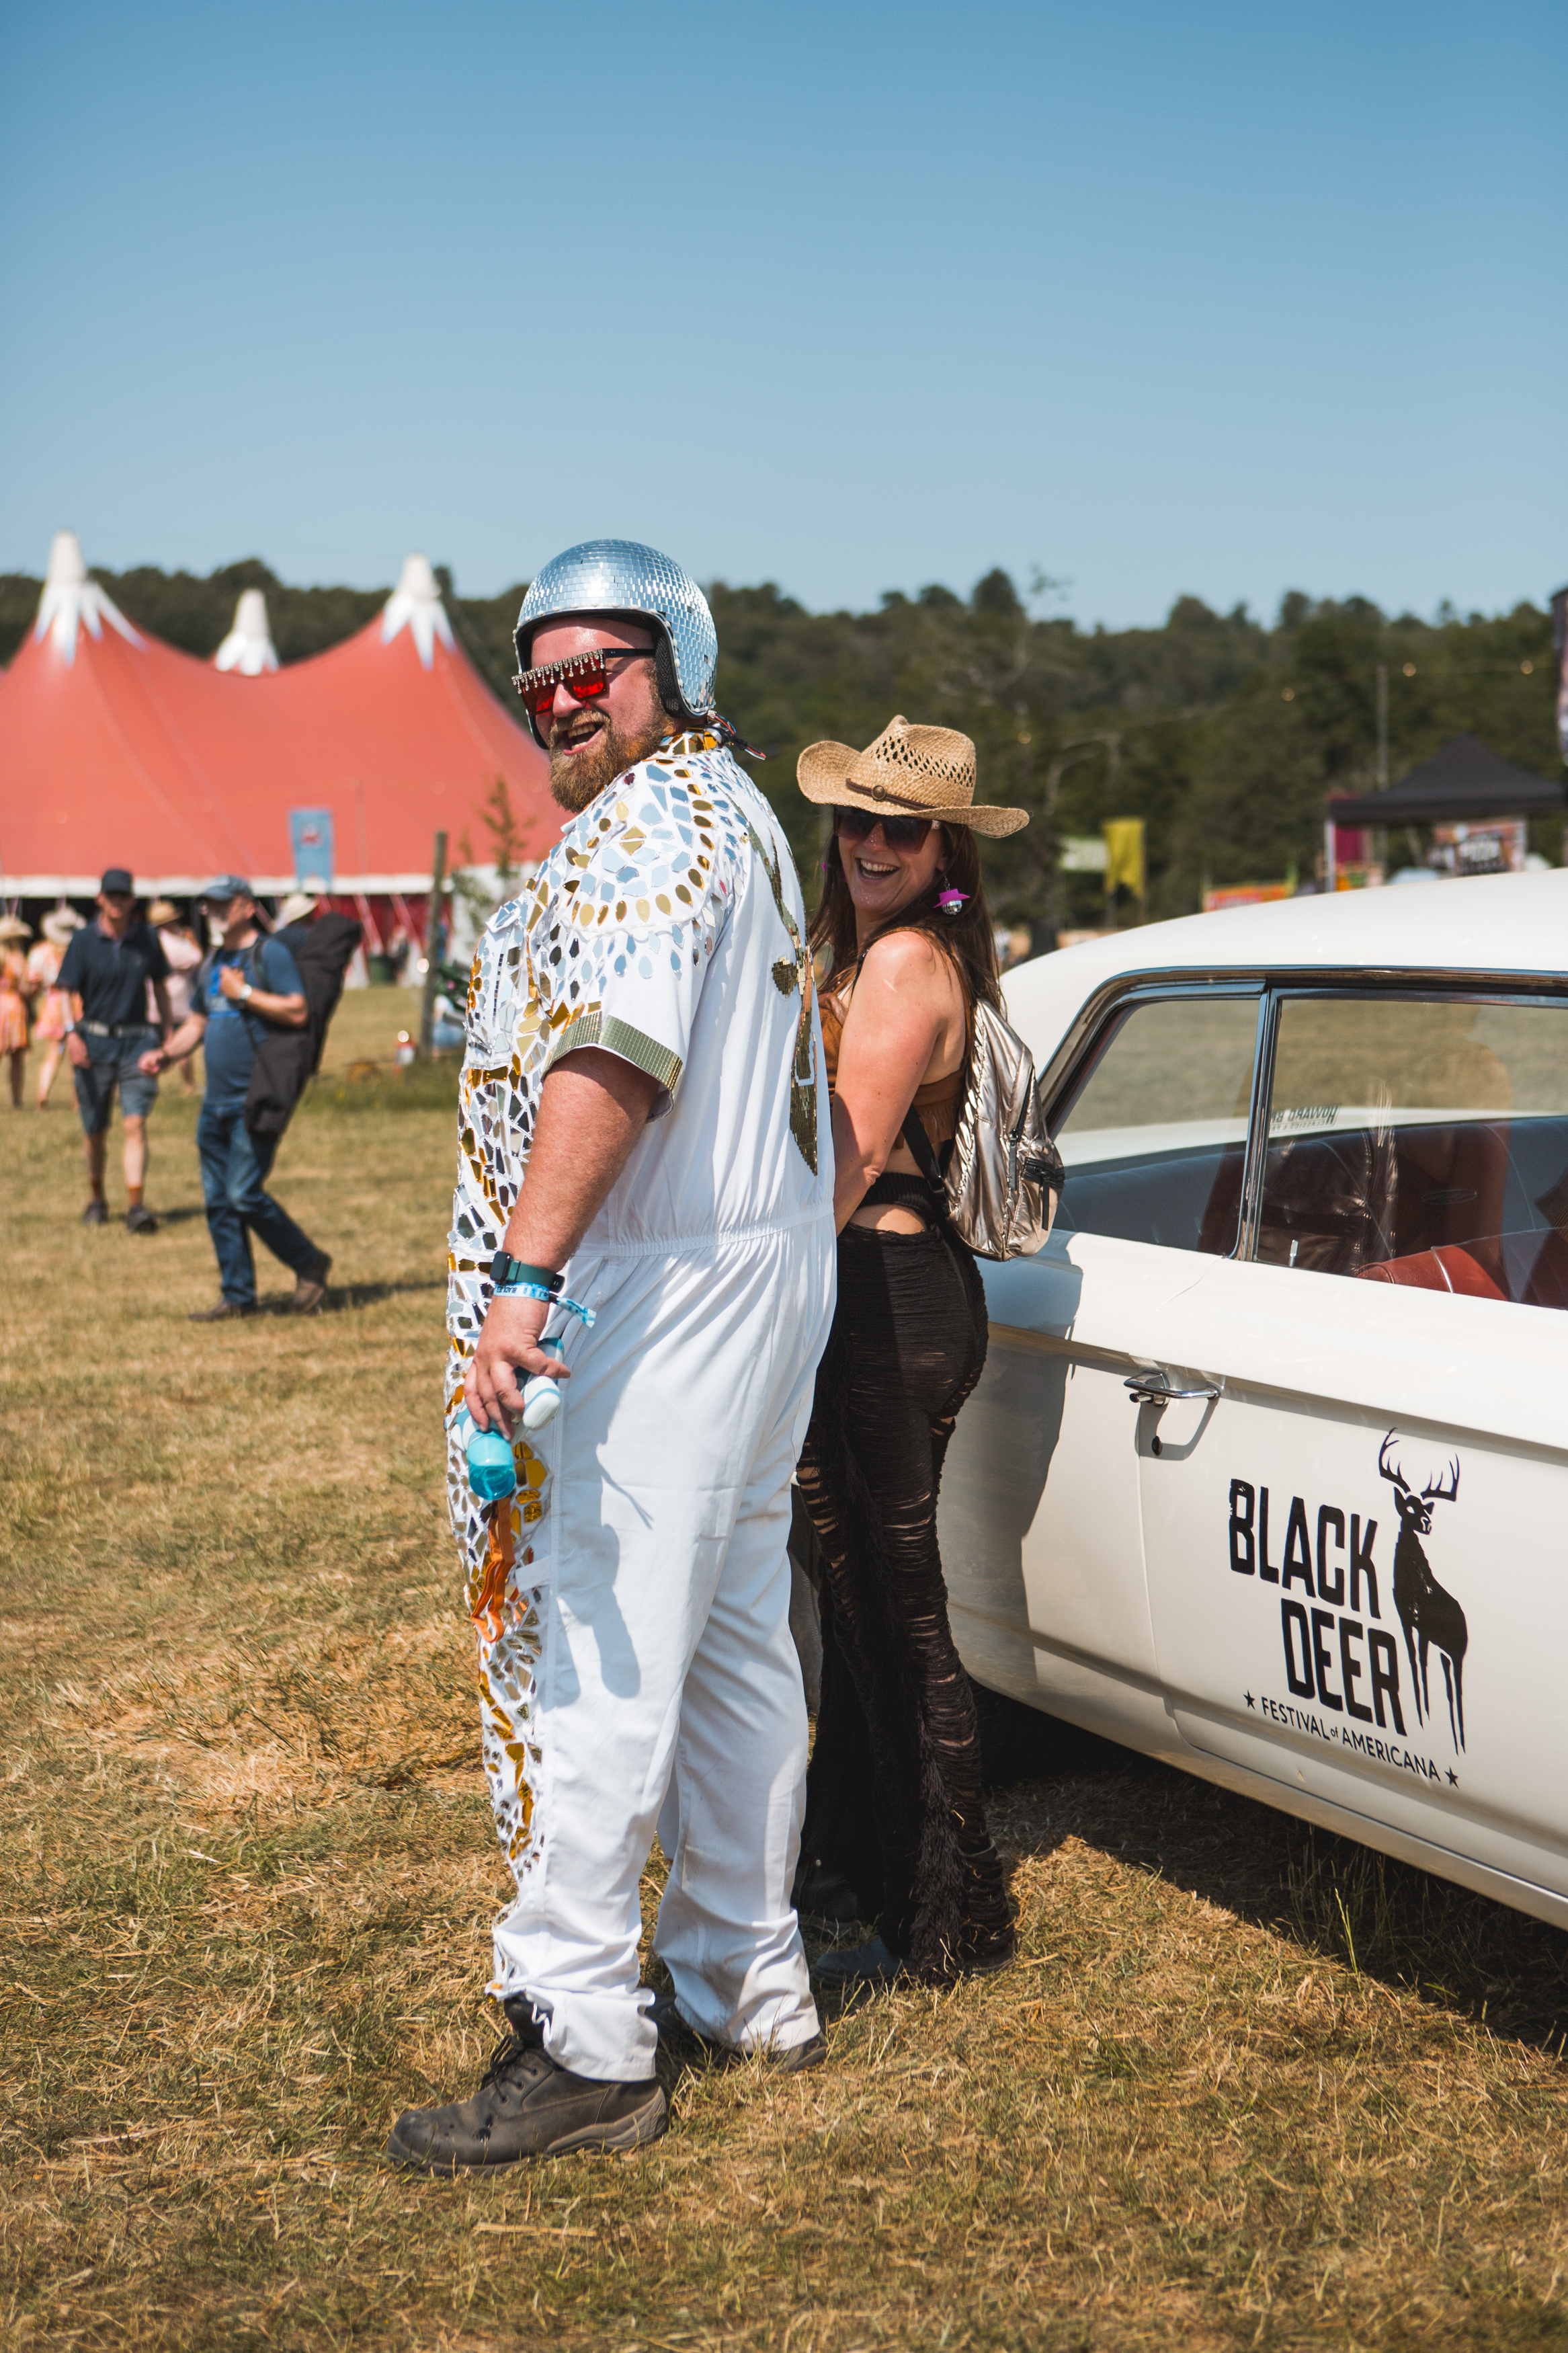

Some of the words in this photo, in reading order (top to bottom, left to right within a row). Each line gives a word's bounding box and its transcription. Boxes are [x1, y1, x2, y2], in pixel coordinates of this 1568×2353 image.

[1229, 1478, 1381, 1619] BLACK
[1281, 1598, 1407, 1737] DEER
[1262, 1696, 1330, 1741] FESTIVAL
[1330, 1726, 1339, 1738] of
[1343, 1726, 1441, 1782] AMERICANA
